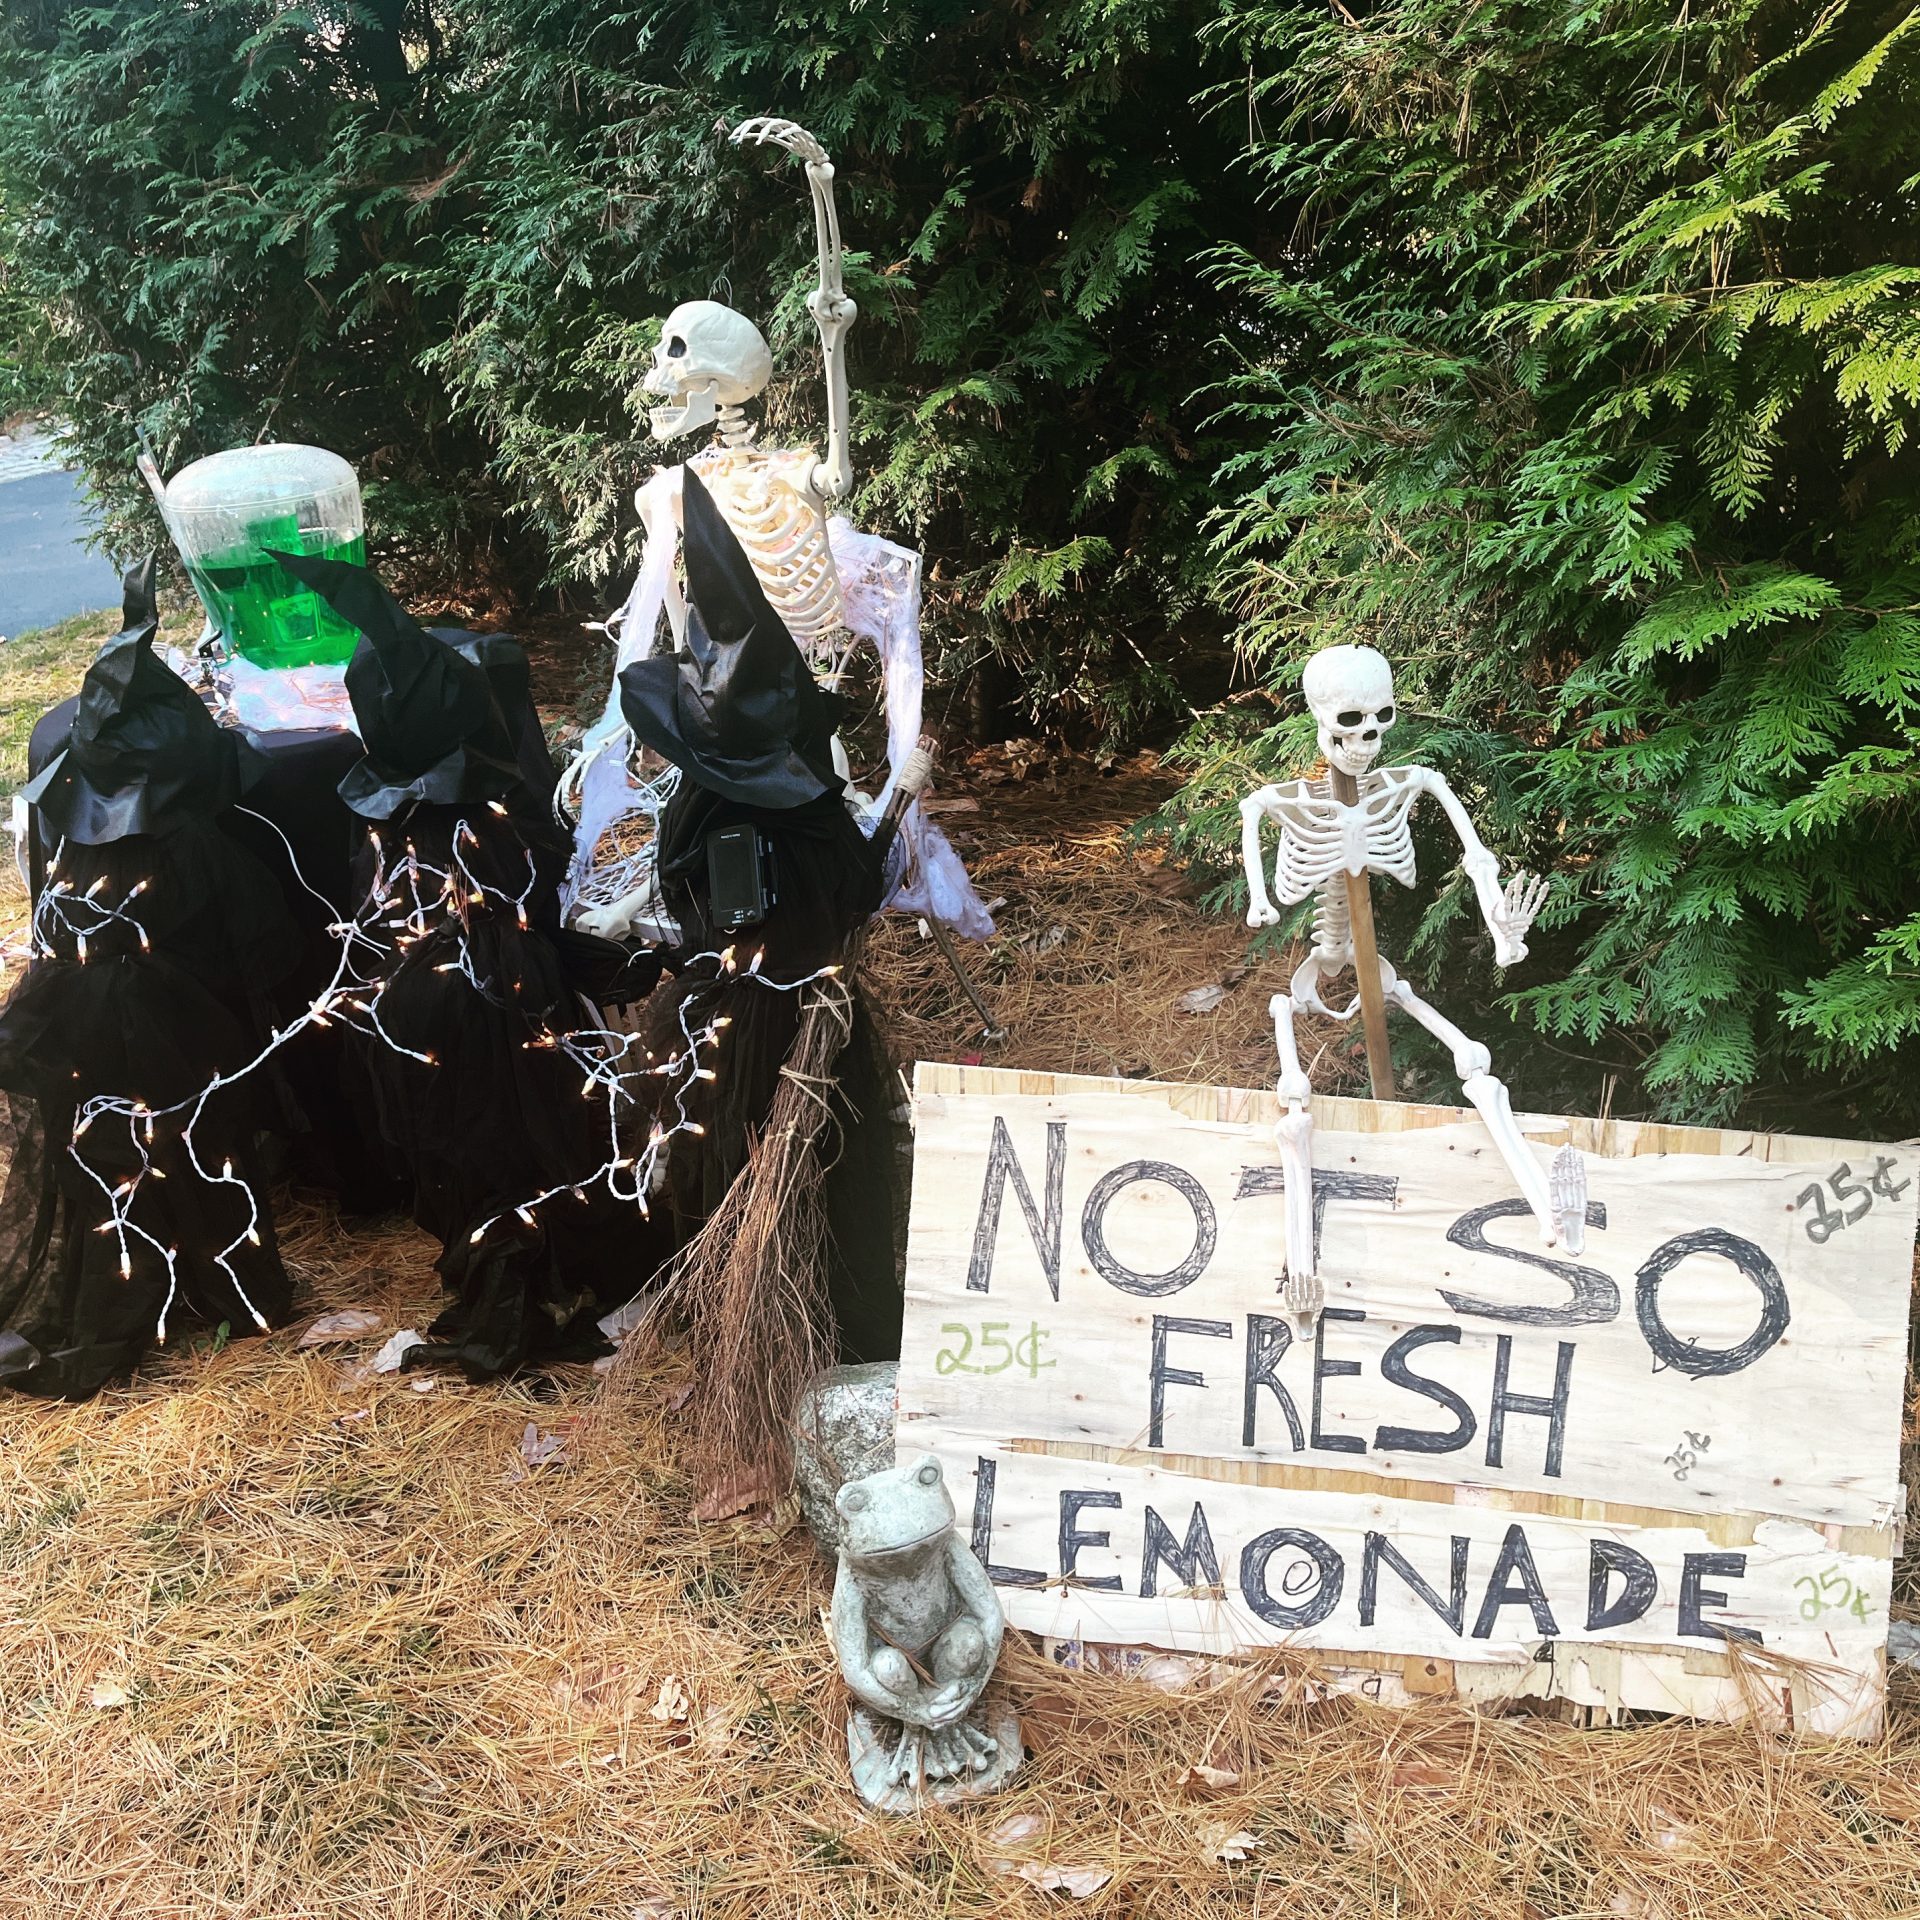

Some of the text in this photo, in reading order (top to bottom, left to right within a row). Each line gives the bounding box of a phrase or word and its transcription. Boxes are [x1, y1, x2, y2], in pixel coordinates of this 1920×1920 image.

[966, 1116, 1791, 1380] NOT SO
[935, 1321, 1057, 1379] 25¢
[1148, 1306, 1577, 1479] FRESH
[969, 1455, 1764, 1645] LEMONADE
[1793, 1565, 1878, 1624] 25¢
